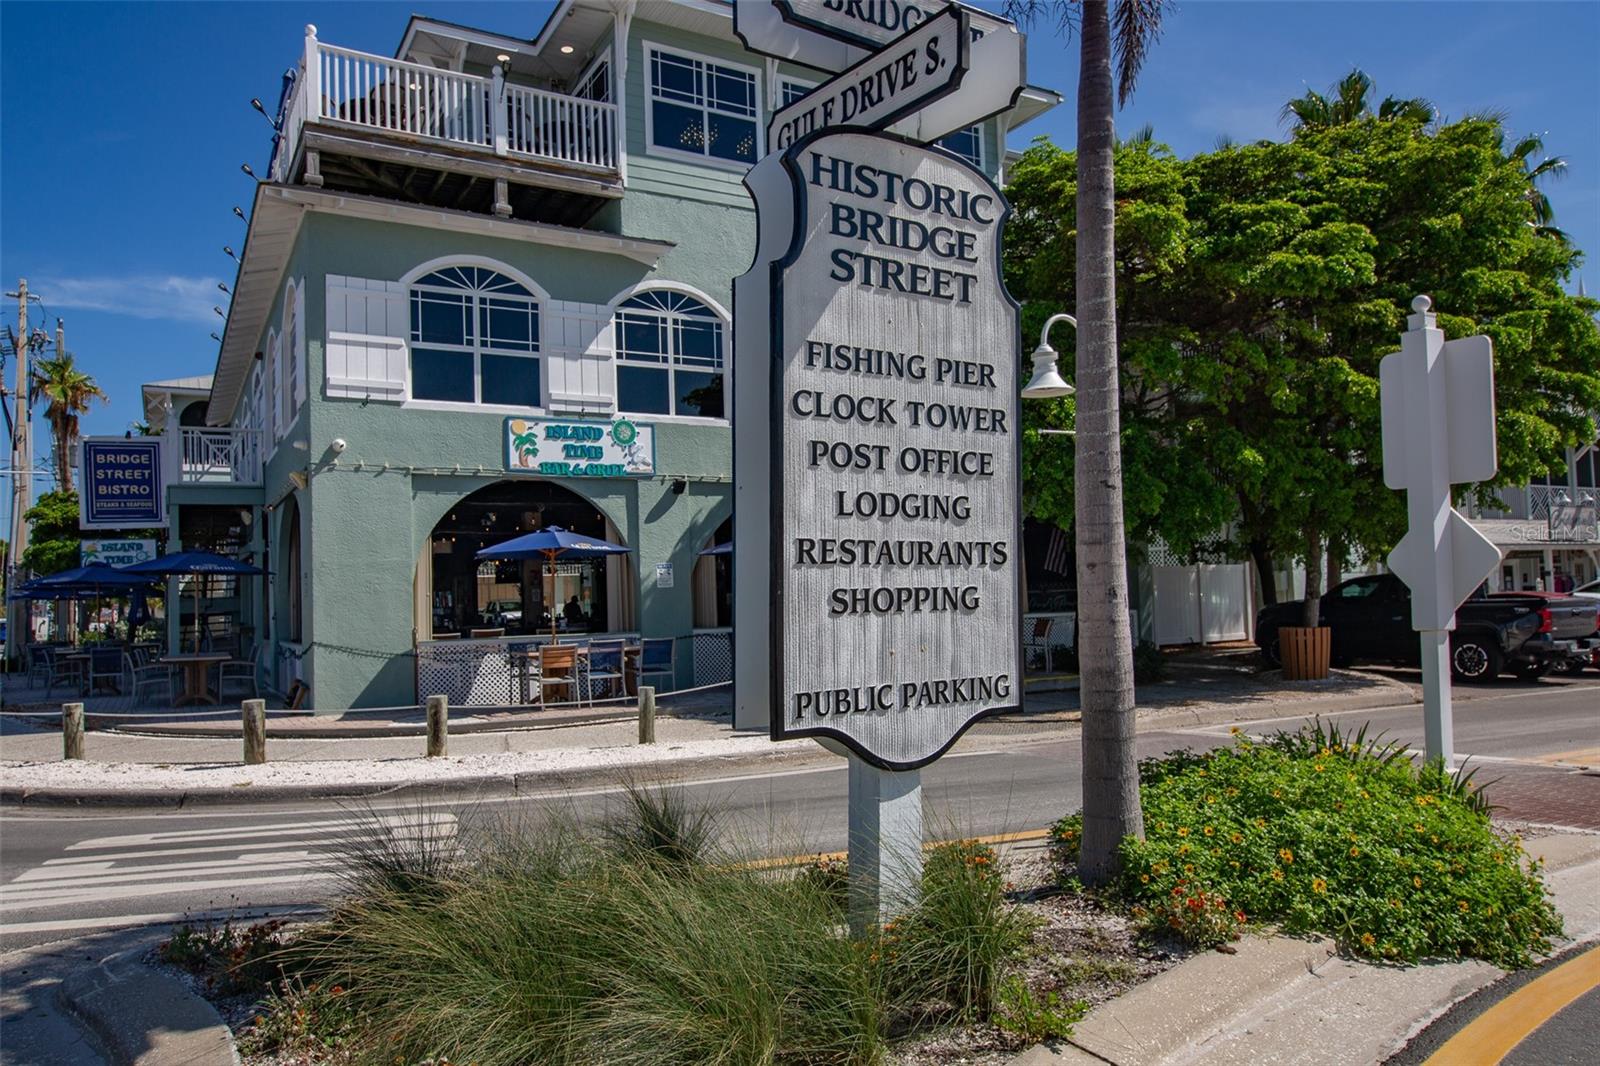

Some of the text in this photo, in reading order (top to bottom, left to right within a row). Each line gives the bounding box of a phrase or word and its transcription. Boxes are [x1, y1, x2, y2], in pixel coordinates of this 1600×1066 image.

[777, 36, 947, 150] GULF DRIVE S.
[809, 152, 994, 225] HISTORIC
[829, 202, 978, 263] BRIDGE
[830, 249, 978, 303] STREET
[806, 340, 997, 388] FISHING PIER
[792, 390, 1008, 433] CLOCK TOWER
[544, 425, 604, 442] ISLAND
[96, 454, 150, 464] BRIDGE
[562, 444, 604, 461] TIME
[809, 440, 994, 476] POST OFFICE
[96, 469, 151, 479] STREET
[539, 462, 571, 475] BAR
[585, 463, 627, 476] GRILL
[98, 485, 149, 495] BISTRO
[837, 490, 971, 519] LODGING
[101, 543, 144, 552] ISLAND
[103, 555, 134, 564] TIME
[794, 538, 1008, 566] RESTAURANTS
[830, 586, 980, 614] SHOPPING
[794, 674, 1010, 719] PUBLIC PARKING
